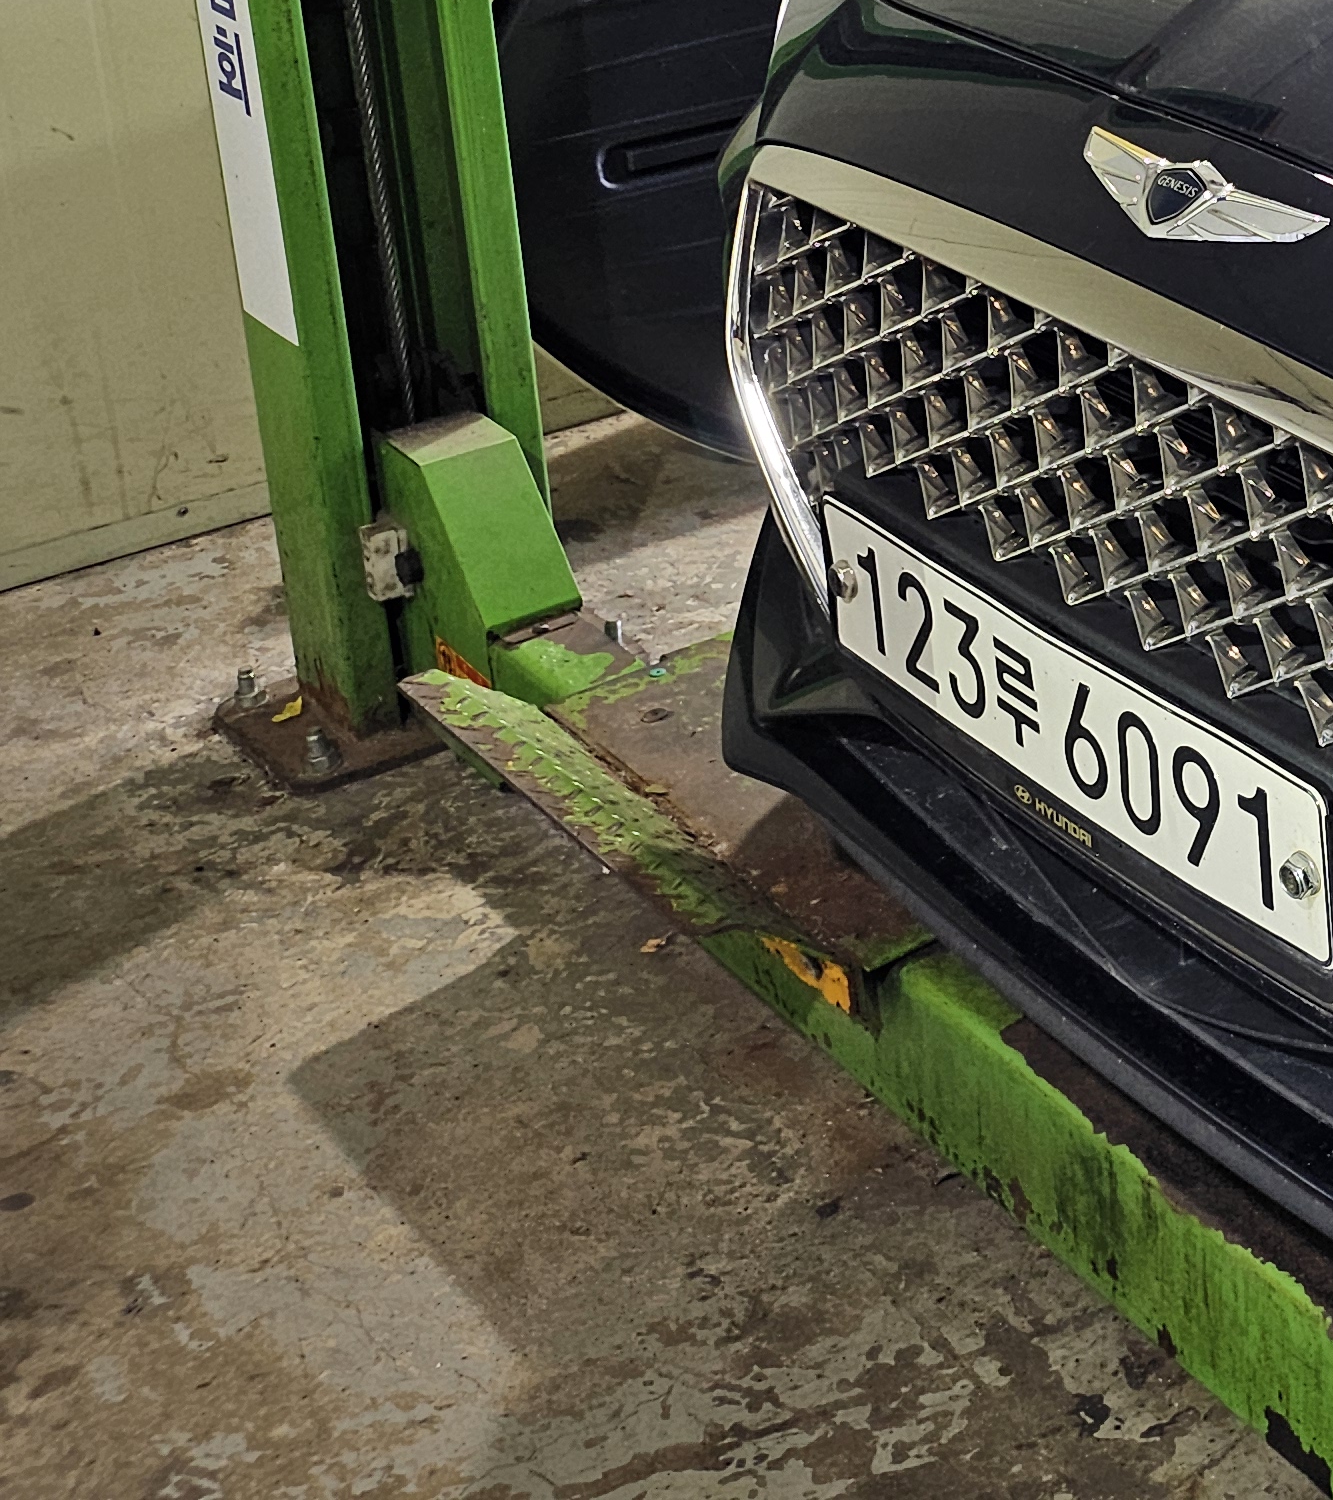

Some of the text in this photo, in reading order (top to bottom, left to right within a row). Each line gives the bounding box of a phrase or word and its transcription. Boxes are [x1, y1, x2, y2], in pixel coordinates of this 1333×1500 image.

[1157, 174, 1199, 198] GENESIS
[856, 545, 1276, 912] 123루 6091
[1034, 797, 1093, 849] HYUNDAI
